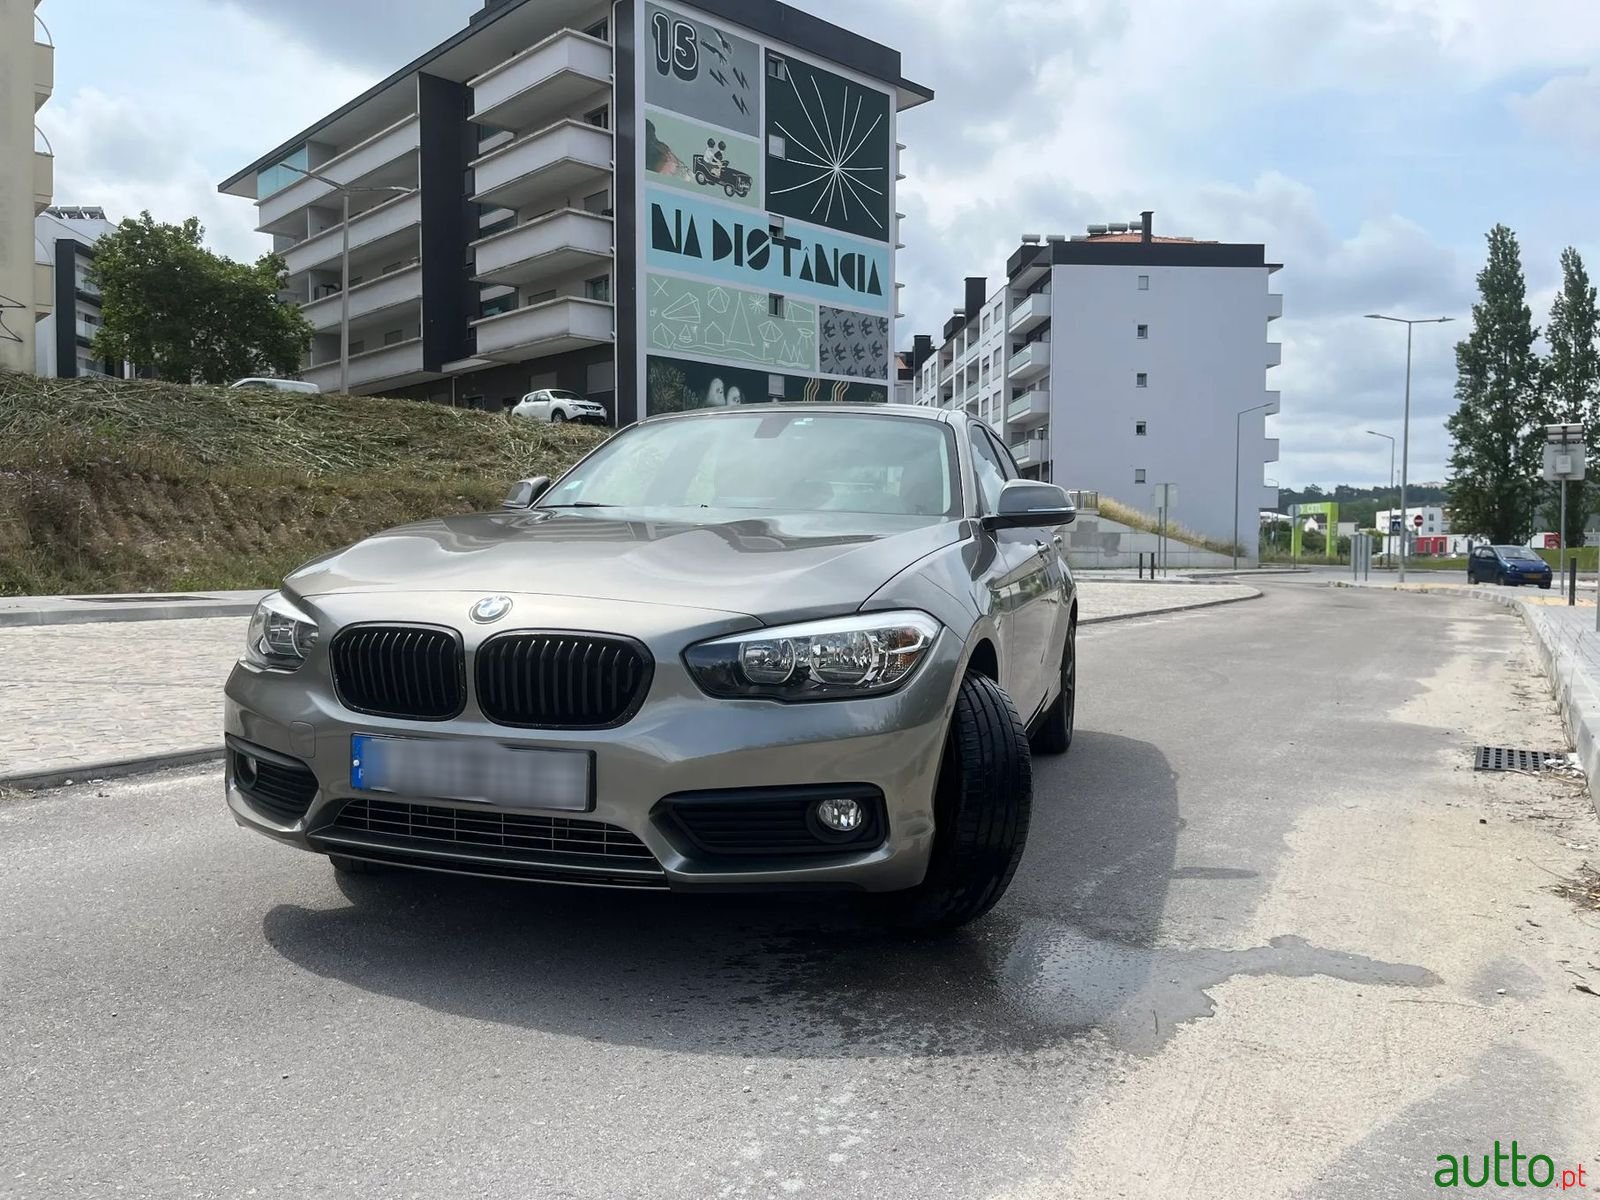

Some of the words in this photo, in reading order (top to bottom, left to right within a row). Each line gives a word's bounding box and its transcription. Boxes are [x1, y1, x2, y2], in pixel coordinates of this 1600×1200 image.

[652, 12, 698, 81] 15
[651, 203, 702, 259] NA
[712, 218, 883, 296] DISTÂNCIA
